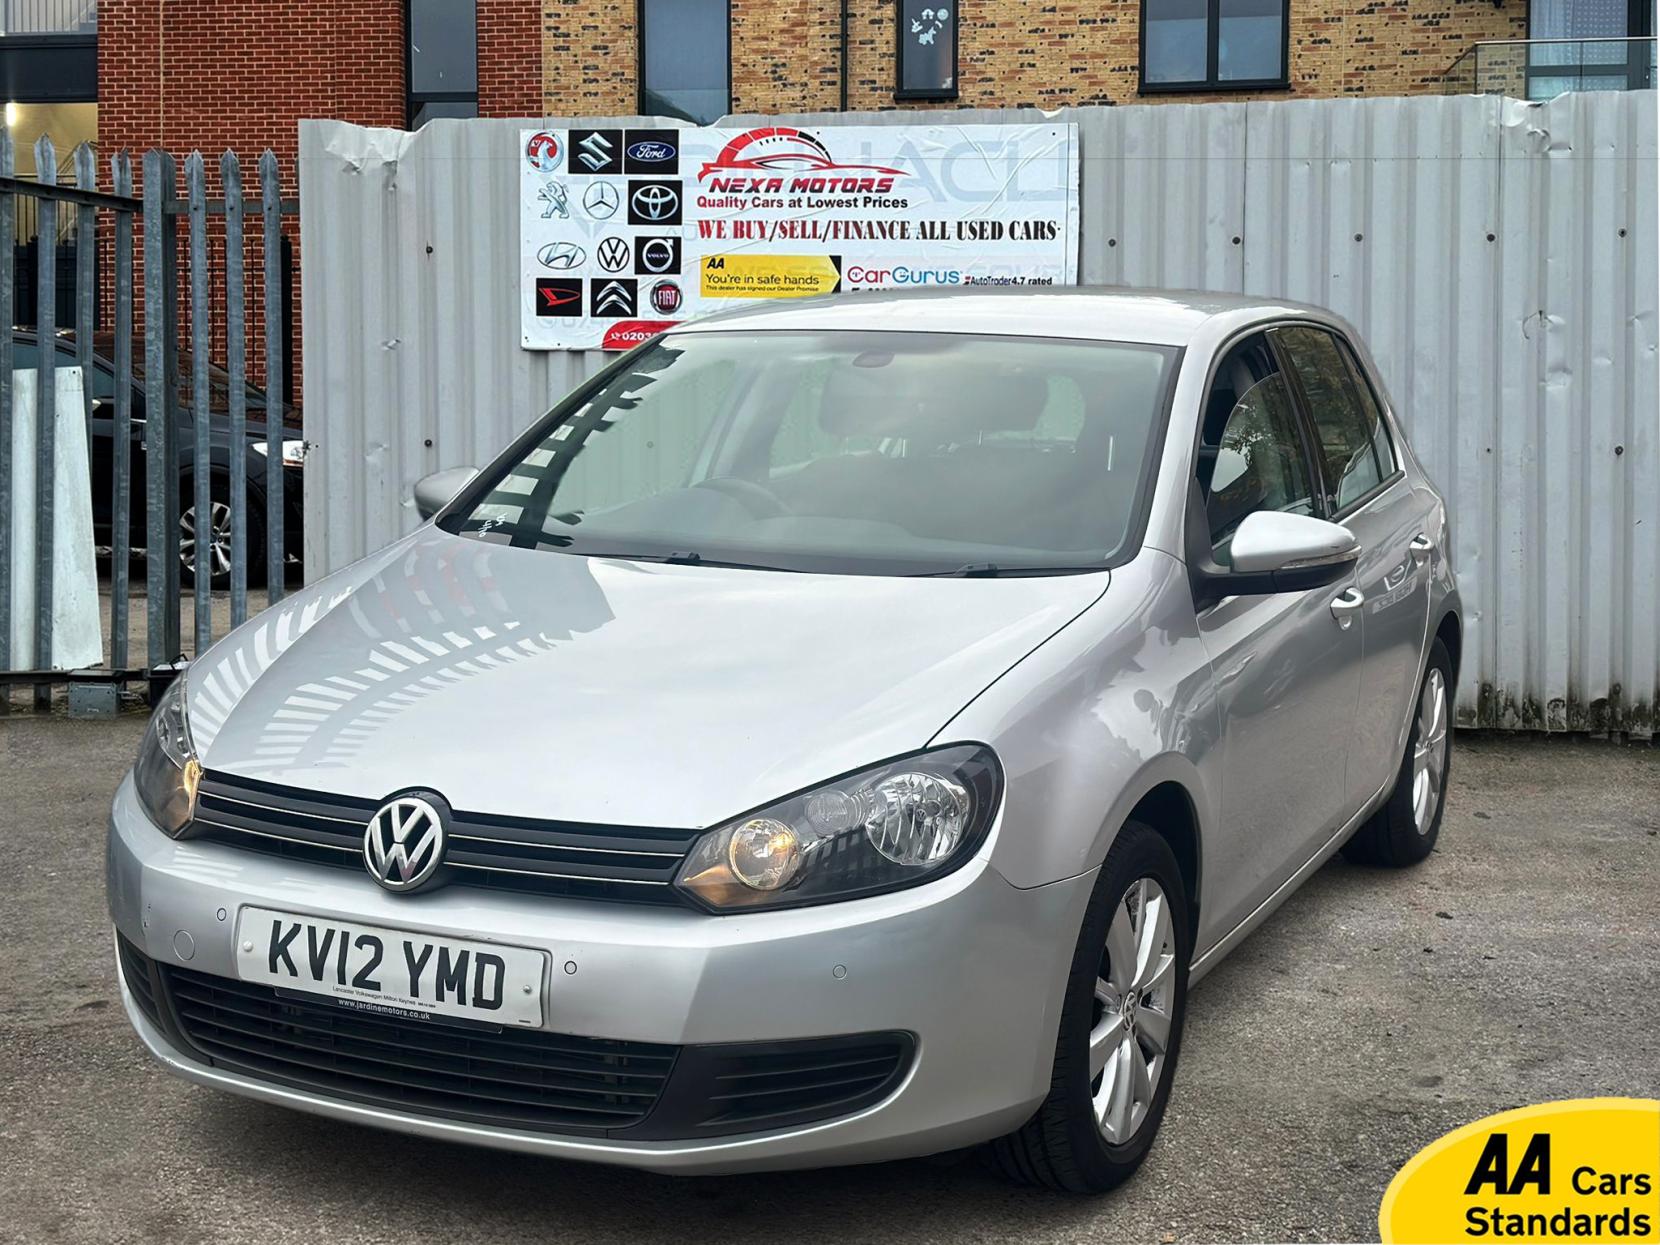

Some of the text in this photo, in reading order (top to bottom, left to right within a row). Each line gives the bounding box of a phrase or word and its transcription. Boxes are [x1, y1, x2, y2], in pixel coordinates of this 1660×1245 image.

[636, 144, 666, 159] Ford
[709, 177, 894, 194] NEXA MOTORS
[697, 196, 908, 210] Quality Cars at Lowest Prices
[697, 219, 727, 240] WE
[916, 220, 951, 241] ALL
[956, 220, 1004, 241] USED
[706, 257, 725, 269] AA
[706, 273, 820, 285] You're in safe hands
[847, 266, 960, 284] CarGurus
[1028, 276, 1053, 286] rated
[658, 289, 676, 306] FIAT
[268, 919, 506, 1011] KV12 YMD
[355, 989, 383, 1000] Volkswagen
[338, 998, 431, 1020] www.jardinemotors.co.uk
